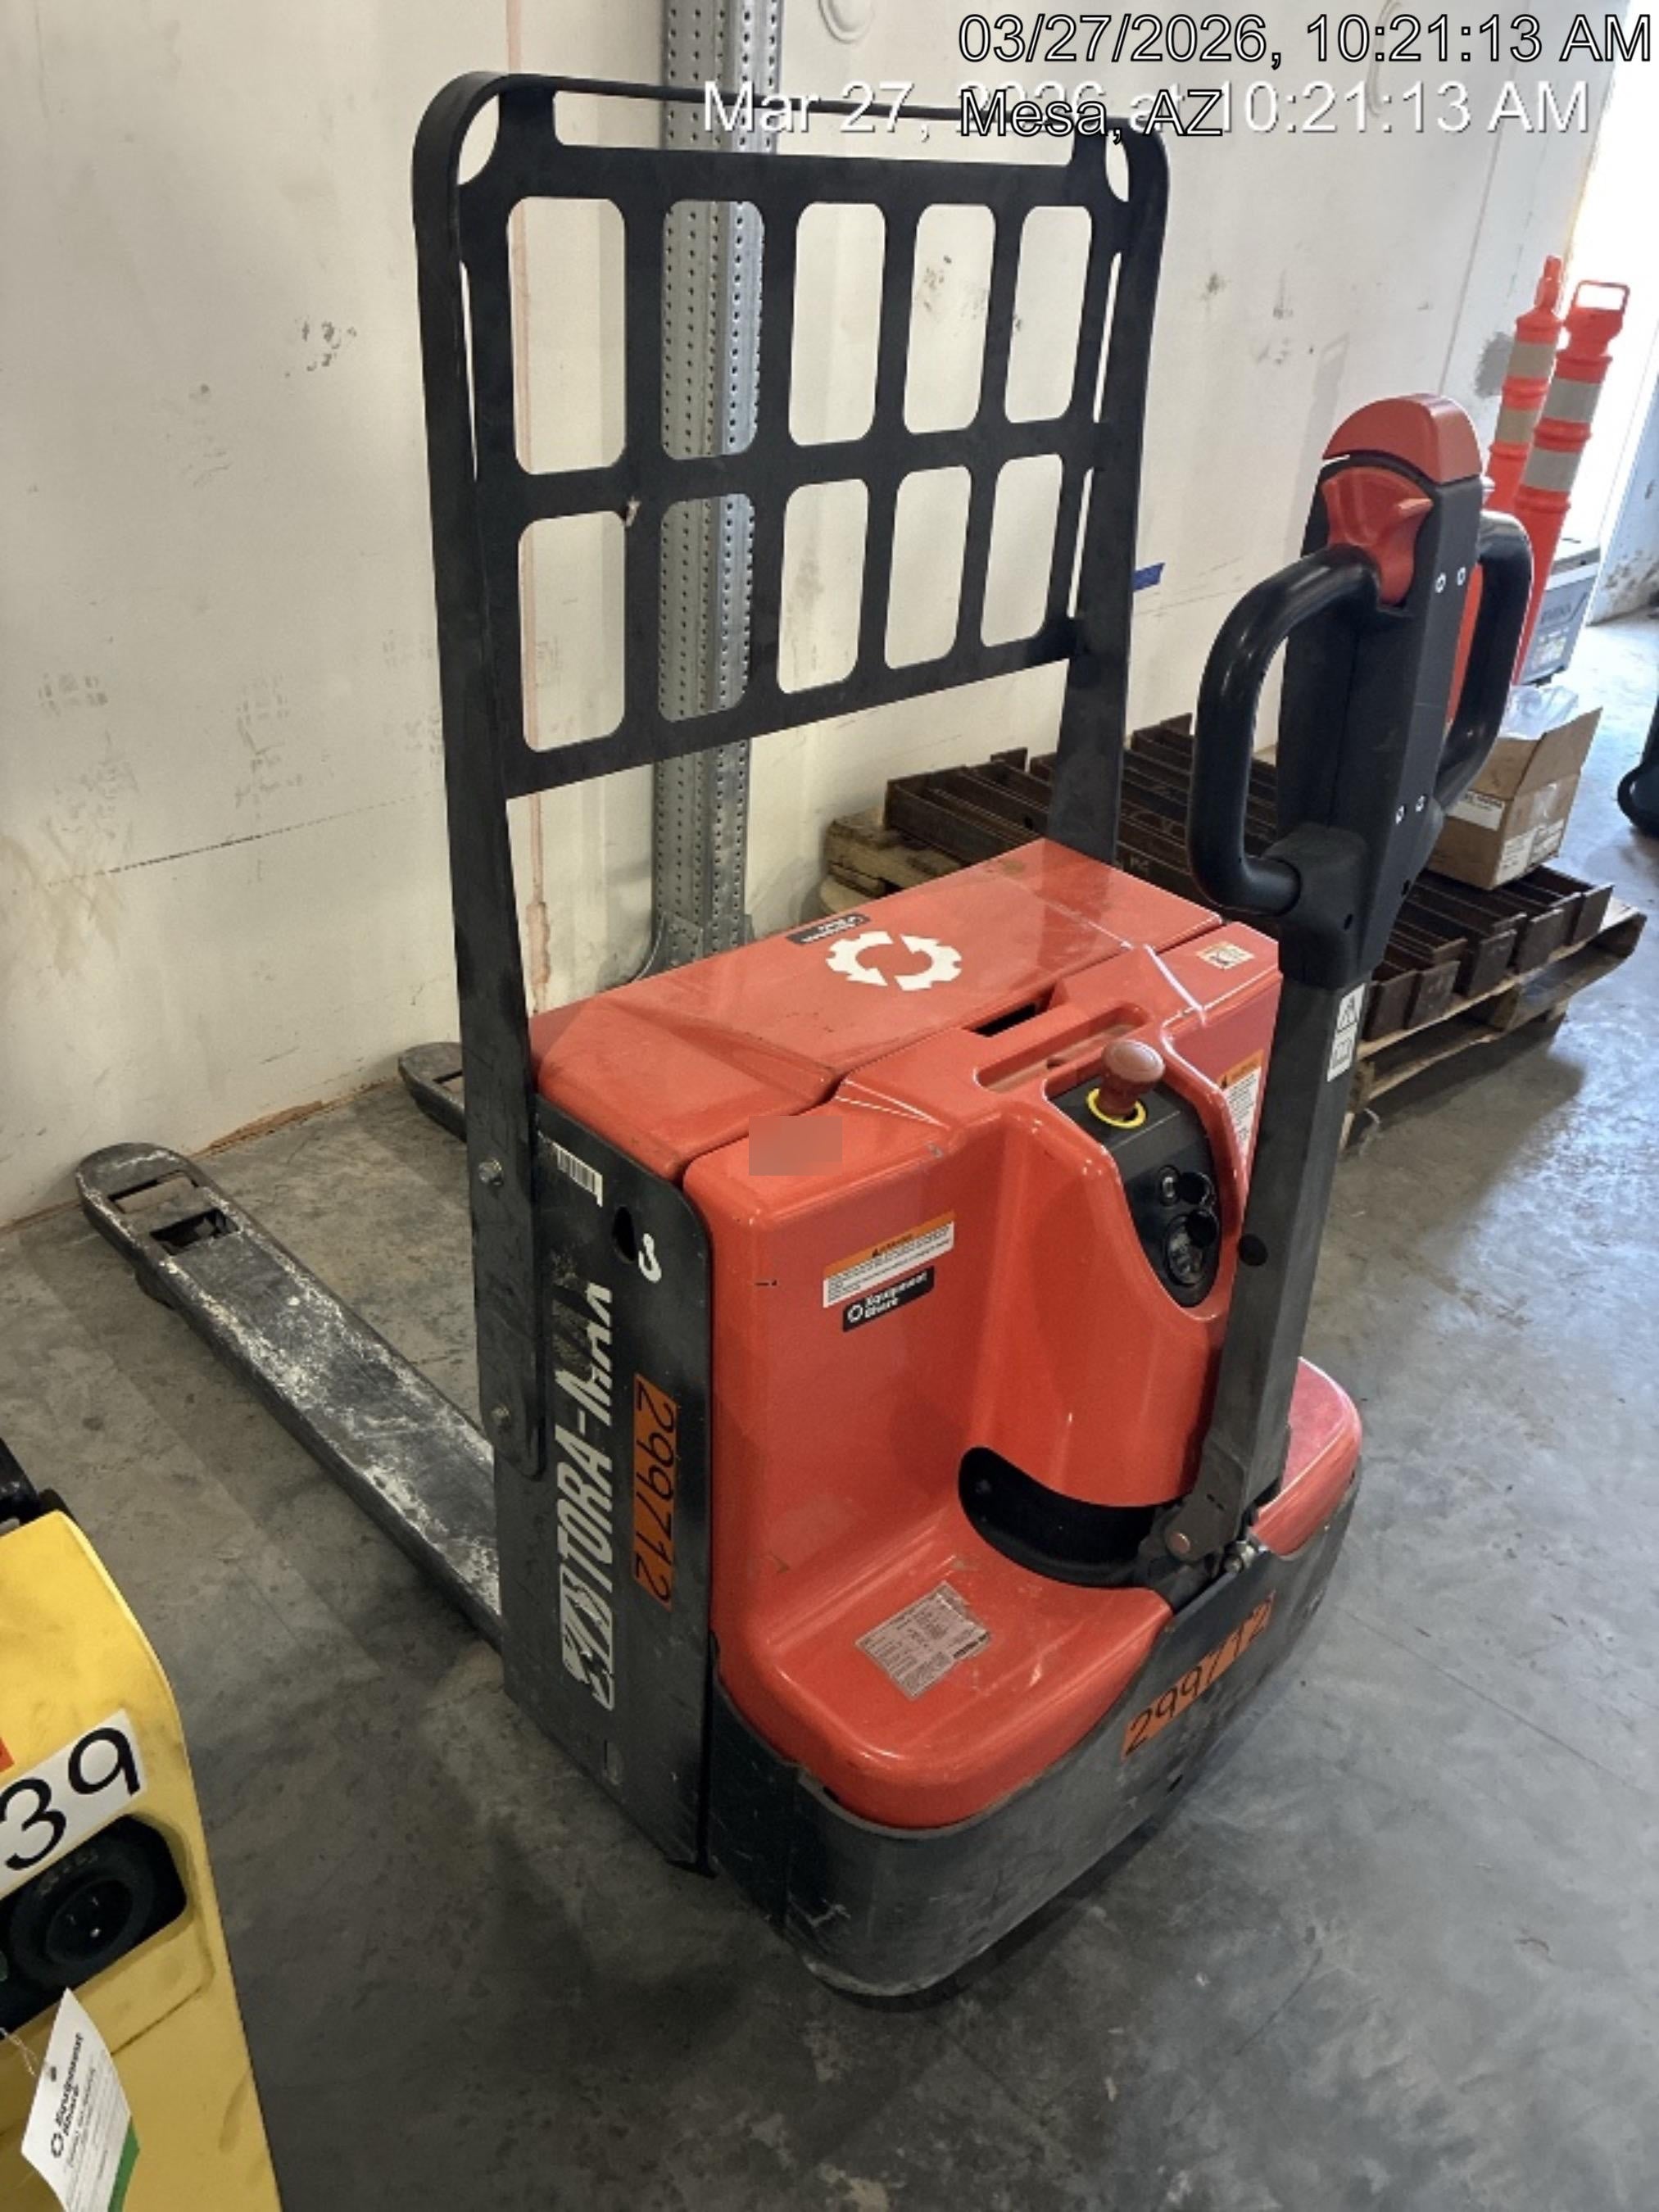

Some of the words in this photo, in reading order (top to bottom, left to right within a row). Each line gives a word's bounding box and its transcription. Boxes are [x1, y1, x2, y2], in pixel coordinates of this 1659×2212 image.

[636, 1376, 675, 1604] 299712
[1125, 1598, 1275, 1756] 299712
[0, 1727, 141, 1871] 39
